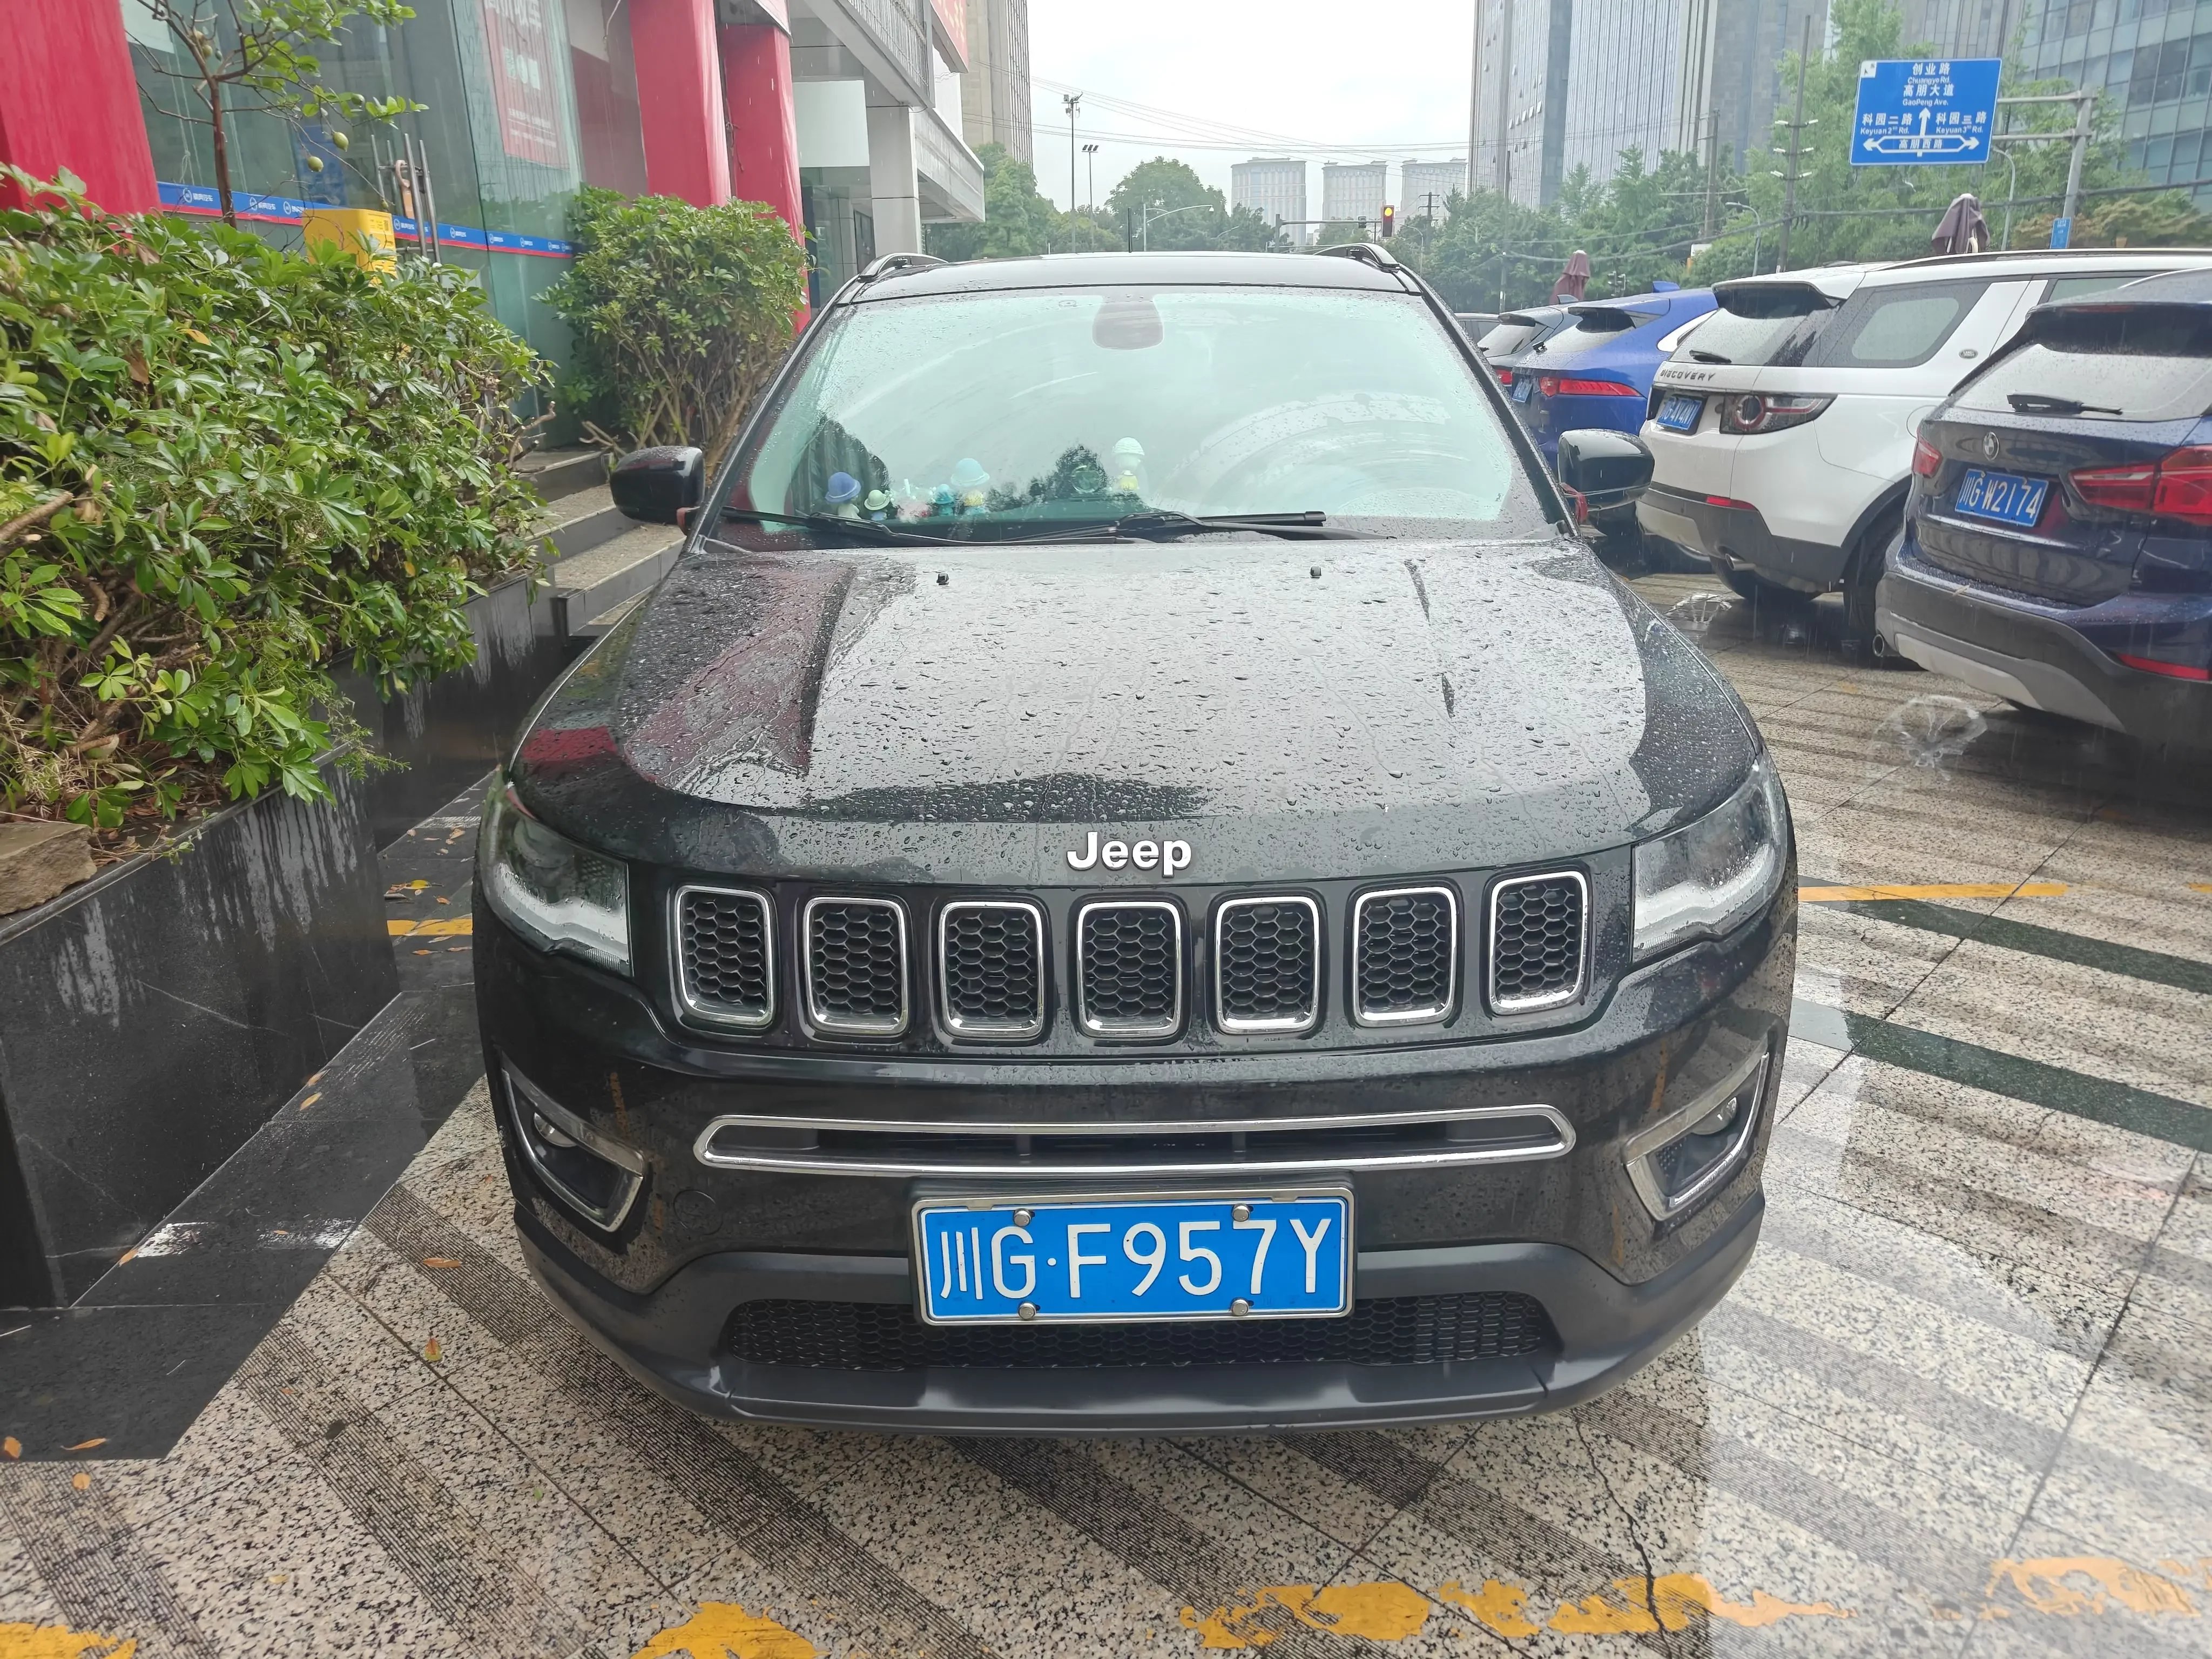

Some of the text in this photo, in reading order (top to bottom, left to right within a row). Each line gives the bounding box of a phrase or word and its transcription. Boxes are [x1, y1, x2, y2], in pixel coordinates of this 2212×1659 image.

[1912, 63, 1950, 75] 创业路
[1908, 77, 1939, 85] Chuangye
[1903, 83, 1954, 97] 高朋大道
[1903, 98, 1932, 107] GaoPeng
[1862, 112, 1912, 126] 科园二路
[1936, 111, 1986, 125] 科园三路
[1860, 127, 1887, 136] Keyuan
[1936, 126, 1961, 135] Keyuan
[1972, 125, 1983, 133] Rd.
[1899, 138, 1943, 150] 高朋西路
[1660, 369, 1716, 381] DISCOVERY
[1067, 831, 1191, 878] Jeep
